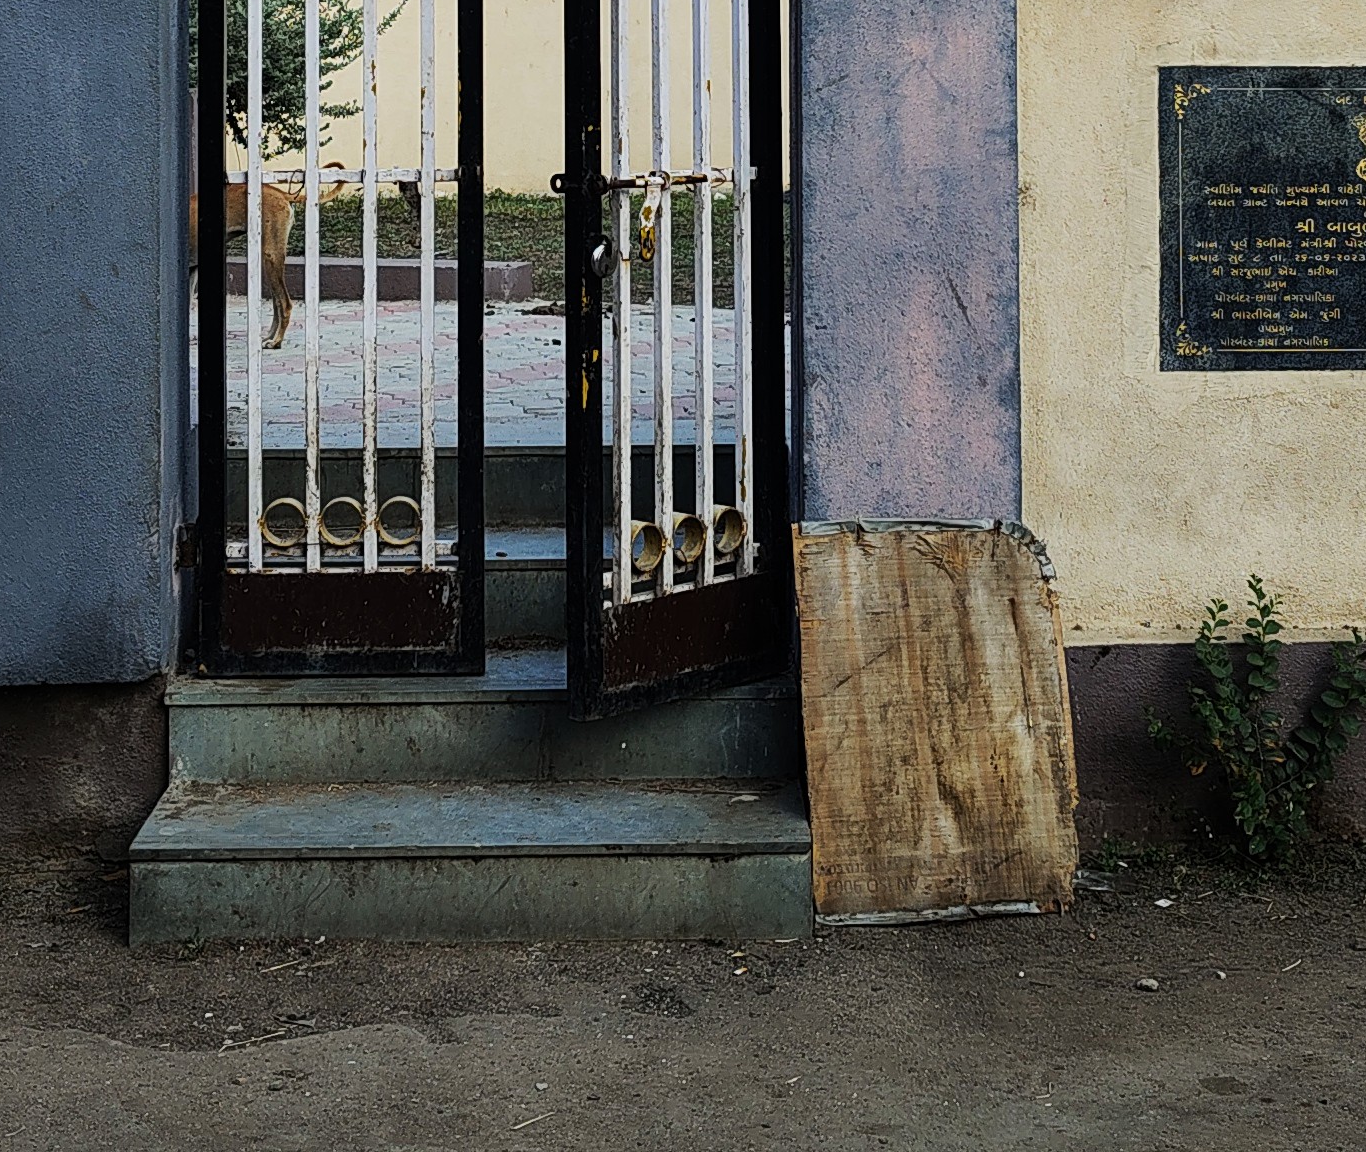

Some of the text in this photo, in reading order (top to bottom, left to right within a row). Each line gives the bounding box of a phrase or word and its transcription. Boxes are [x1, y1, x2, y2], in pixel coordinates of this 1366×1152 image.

[1337, 183, 1364, 195] શહેરી
[1207, 199, 1236, 207] બચત
[1242, 199, 1269, 207] ગ્રાન્ટ
[1316, 198, 1349, 207] આવળ
[1294, 218, 1316, 233] શ્રી
[1229, 237, 1249, 251] પૂર્વ
[1255, 237, 1293, 249] કેબીનેટ
[1300, 237, 1338, 248] મંત્રીશ્રી
[1227, 253, 1246, 265] સુદ
[1252, 254, 1262, 262] ૮
[1210, 265, 1224, 276] શ્રી
[1262, 280, 1288, 292] પ્રમુખ
[1282, 291, 1336, 302] નગરપાલિકા
[1210, 308, 1225, 320] શ્રી
[1231, 308, 1282, 320] ભારતીબેન
[1282, 336, 1334, 347] નગરપાલિક
